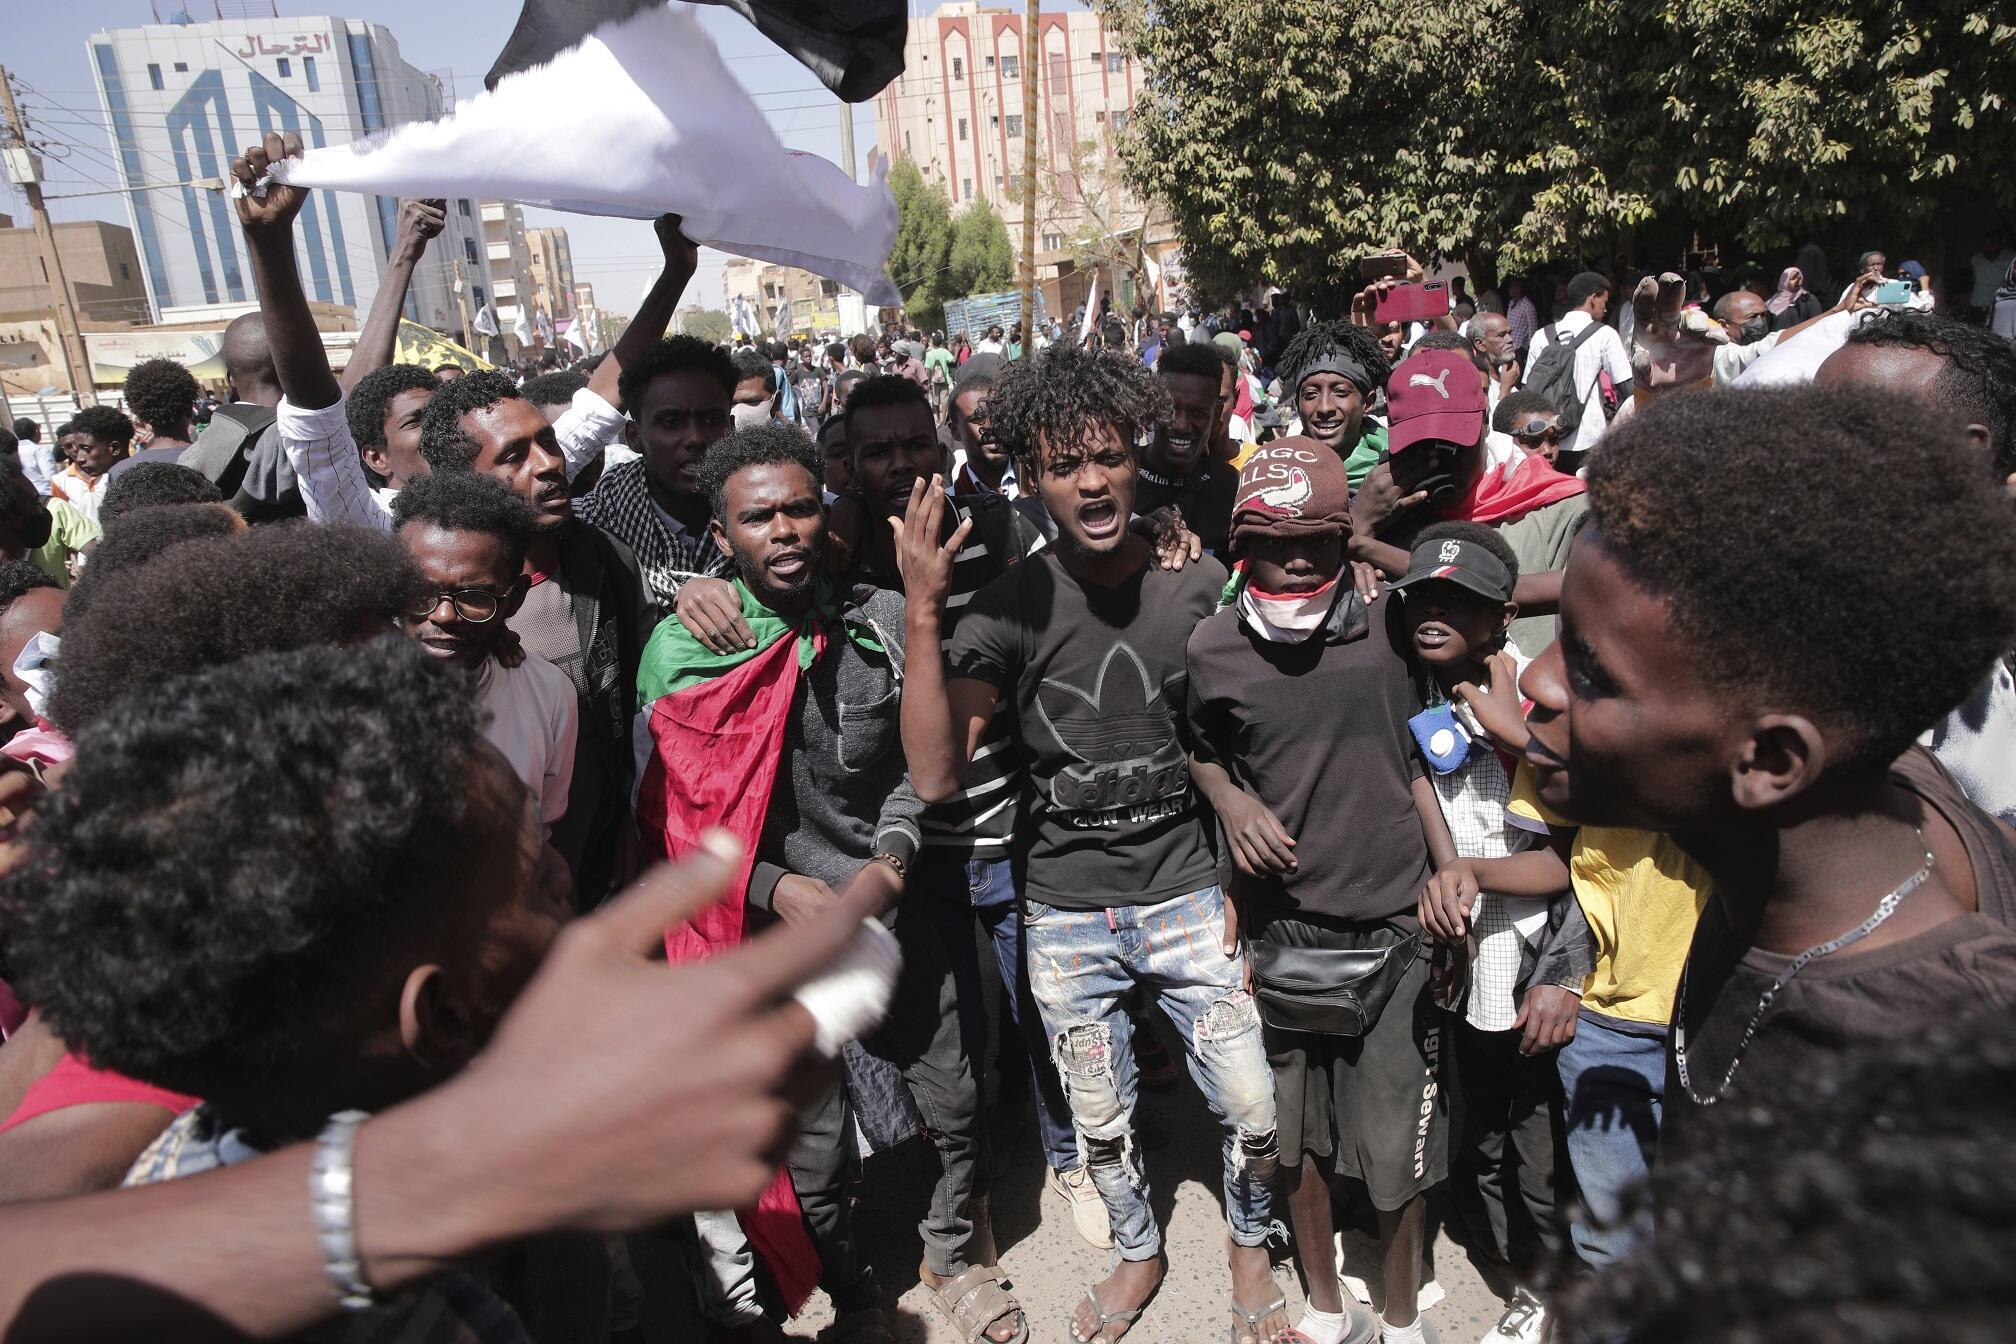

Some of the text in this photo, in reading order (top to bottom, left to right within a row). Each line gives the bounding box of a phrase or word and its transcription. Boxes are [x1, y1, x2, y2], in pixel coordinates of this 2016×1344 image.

[238, 31, 330, 58] الترحال
[1241, 463, 1289, 487] LLS
[1053, 761, 1188, 809] adidas
[1128, 798, 1184, 824] WEAR
[1414, 1082, 1438, 1179] Sewarn
